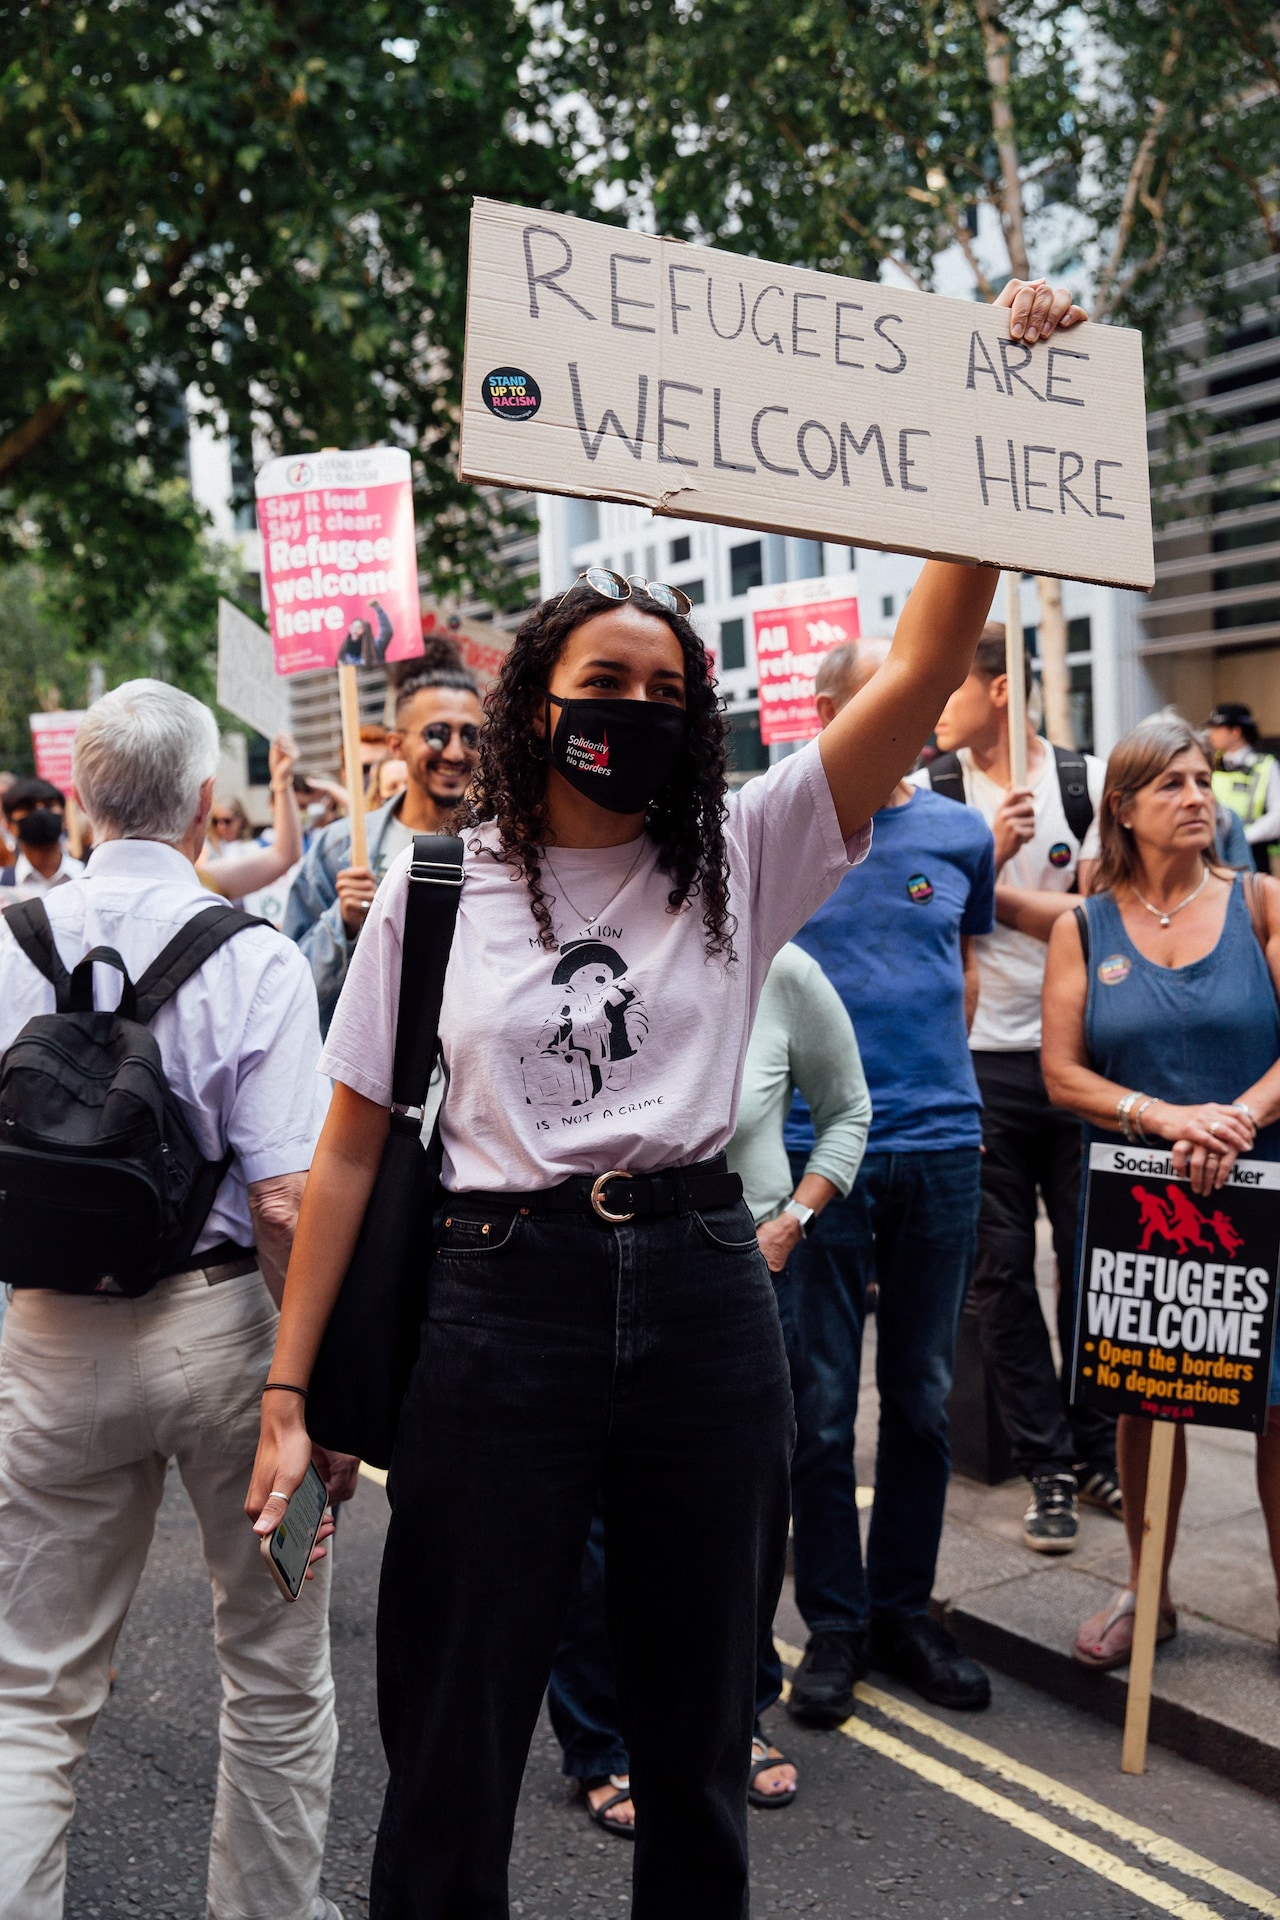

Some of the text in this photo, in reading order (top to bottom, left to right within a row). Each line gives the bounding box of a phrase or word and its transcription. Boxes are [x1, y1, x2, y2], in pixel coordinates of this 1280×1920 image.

[523, 224, 1090, 406] REFUGEES ARE
[489, 376, 526, 386] STAND
[490, 387, 526, 396] UP TO
[492, 396, 536, 406] RACISM
[567, 361, 1126, 520] WELCOME HERE
[265, 498, 300, 520] Say
[323, 490, 367, 511] loud
[267, 519, 302, 541] Say
[269, 534, 395, 574] Refugee
[275, 605, 345, 639] here
[757, 625, 789, 653] All
[566, 745, 595, 760] Knows
[568, 735, 609, 754] Solidarity
[566, 755, 612, 775] No Borders
[528, 924, 623, 948] MTION
[536, 1095, 664, 1130] IS NOT A CRIME
[1114, 1151, 1176, 1177] Sociali
[1089, 1247, 1270, 1313] REFUGEES
[1087, 1290, 1264, 1359] WELCOME
[1097, 1339, 1255, 1382] Open the borders
[1096, 1363, 1241, 1406] No deportations
